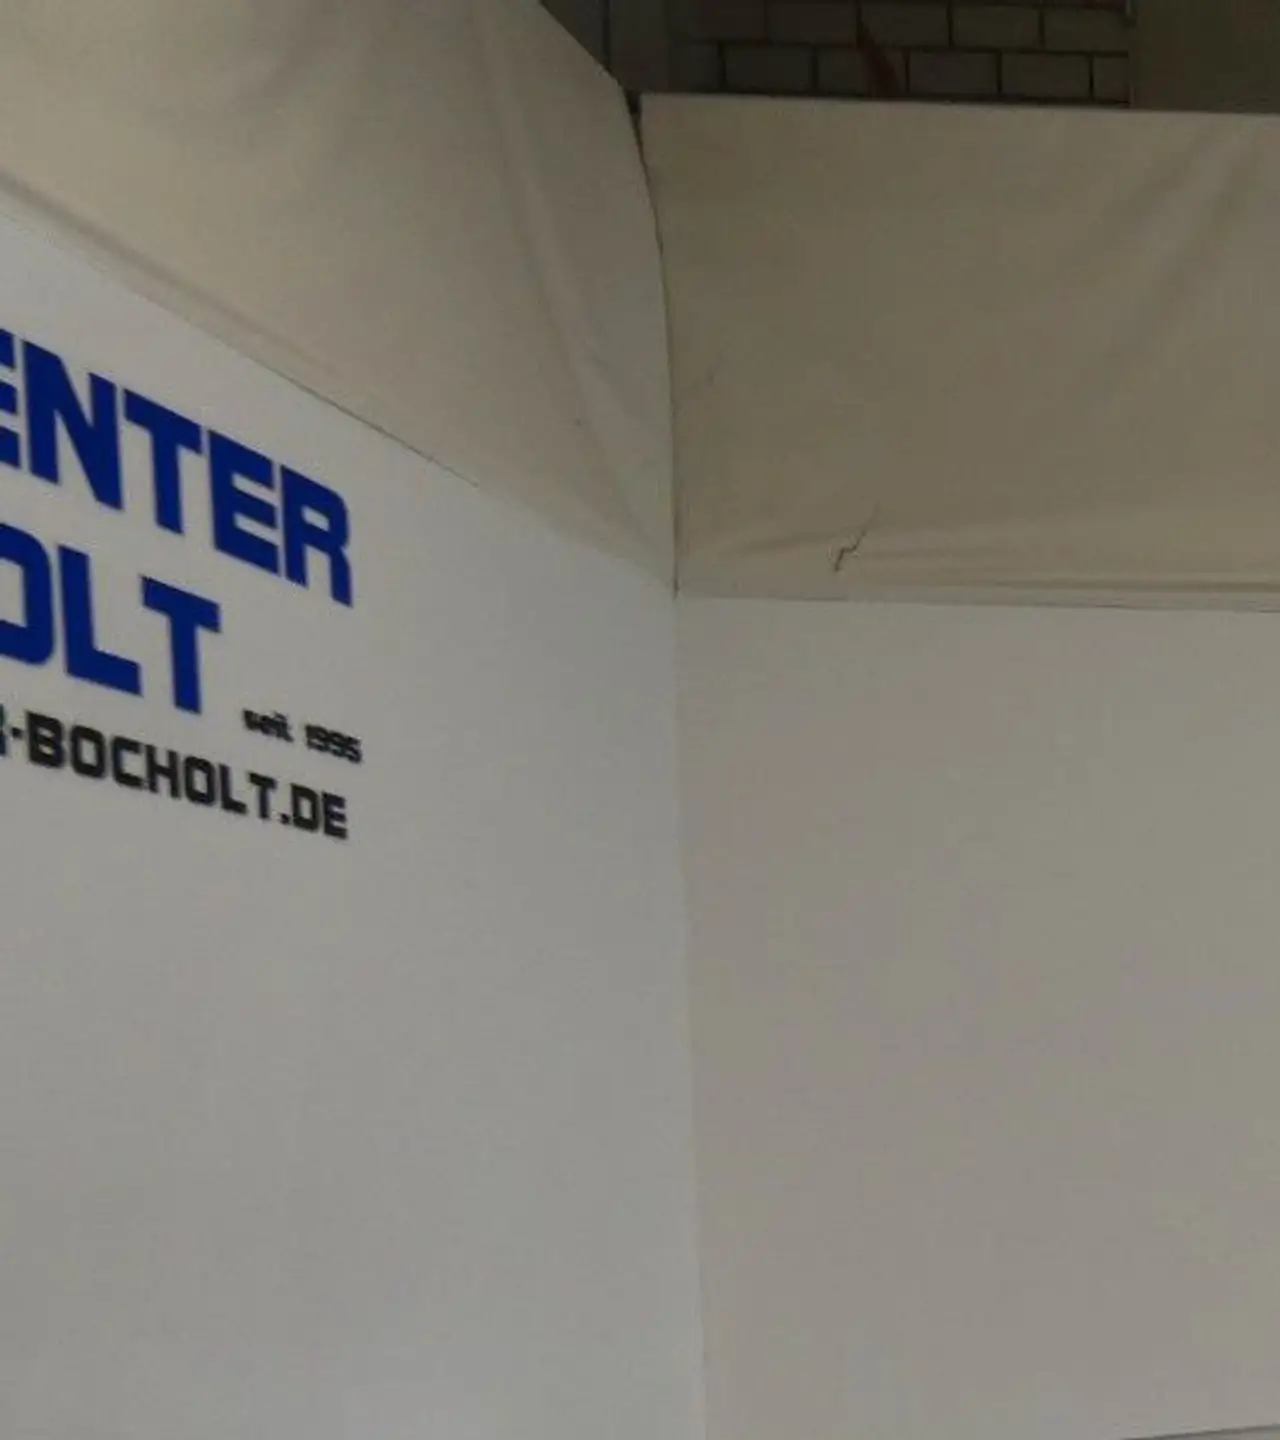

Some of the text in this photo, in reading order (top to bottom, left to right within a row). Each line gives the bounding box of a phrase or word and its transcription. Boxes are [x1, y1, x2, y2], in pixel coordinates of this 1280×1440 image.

[0, 330, 353, 608] NTER
[0, 703, 349, 840] -BOCHOLT.DE
[304, 723, 363, 764] 1995
